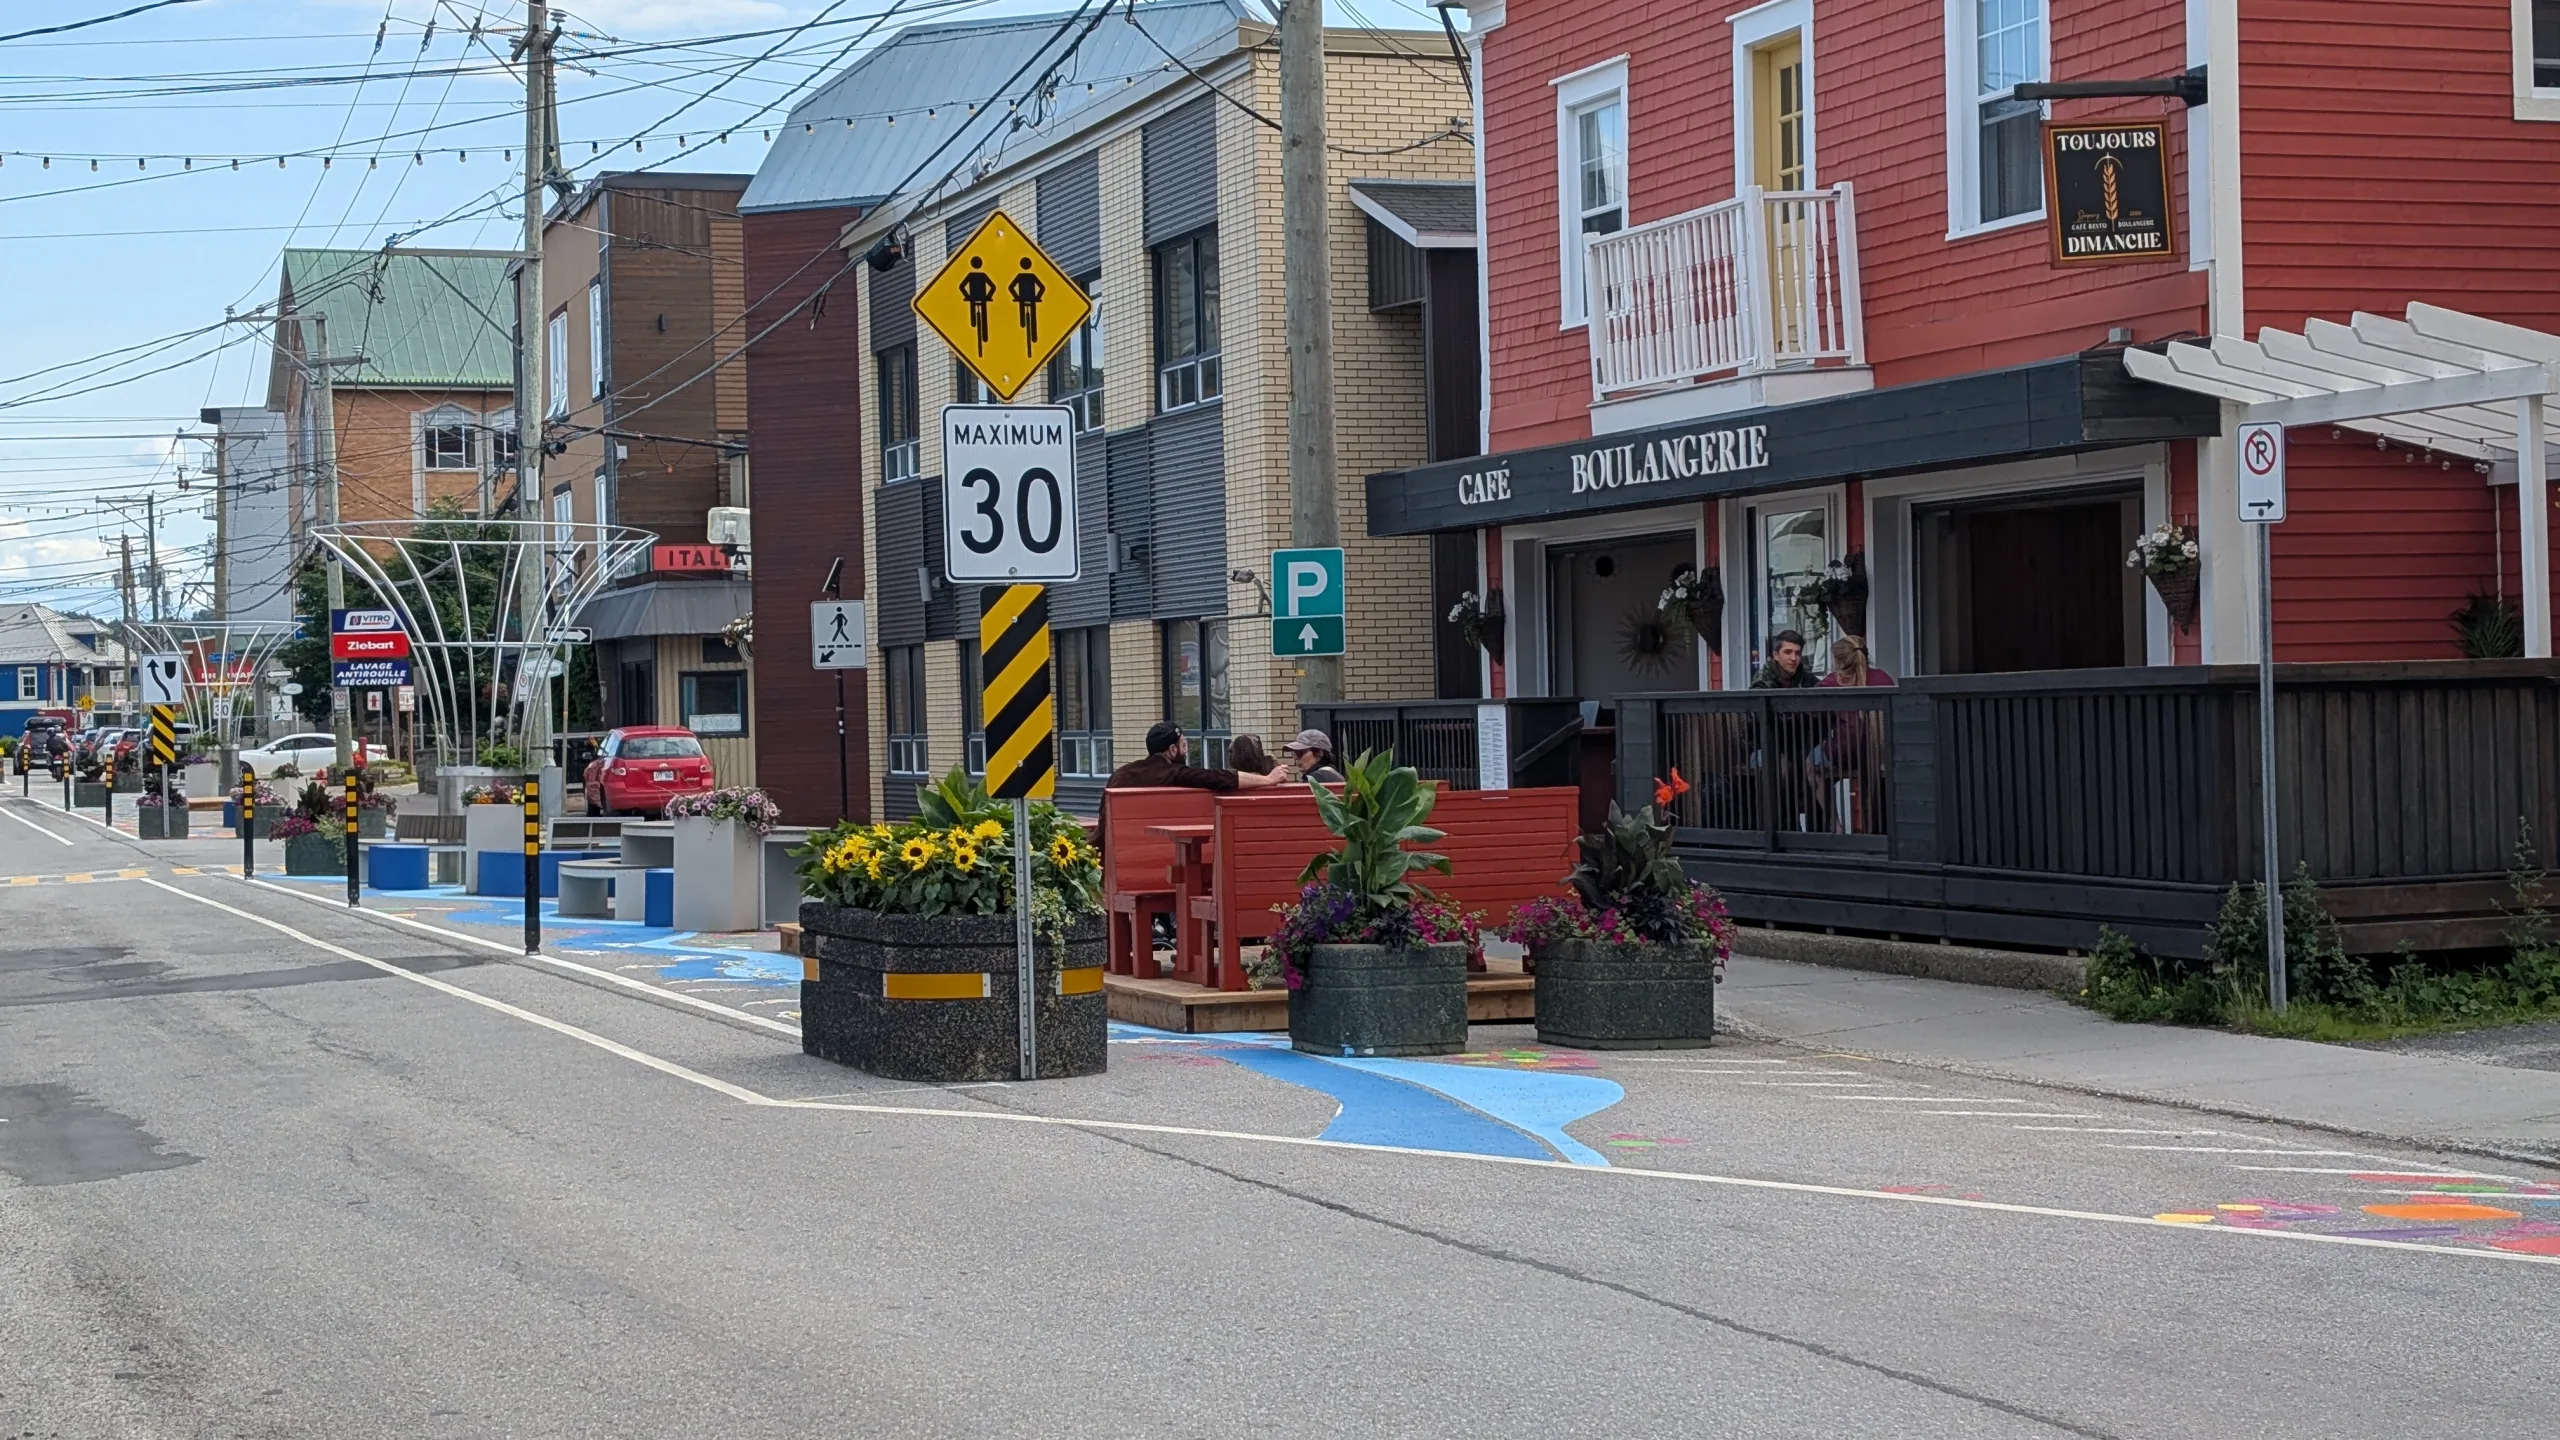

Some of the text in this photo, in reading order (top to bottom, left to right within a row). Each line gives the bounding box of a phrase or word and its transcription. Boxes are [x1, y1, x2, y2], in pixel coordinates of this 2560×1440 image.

[2057, 131, 2156, 151] TOUJOURS
[2118, 219, 2155, 228] BOULANGERIE
[2067, 232, 2162, 253] DIMANCHE
[954, 424, 1063, 446] MAXIMUM
[1458, 424, 1770, 506] CAFÉ BOULANGERIE
[960, 467, 1063, 554] 30
[1287, 561, 1328, 617] P
[362, 614, 391, 623] VITRO
[347, 640, 395, 651] Ziebart
[336, 669, 407, 678] ANTIROUILLE
[350, 662, 393, 671] LAVAGE
[340, 677, 403, 686] MÉCANIQUE
